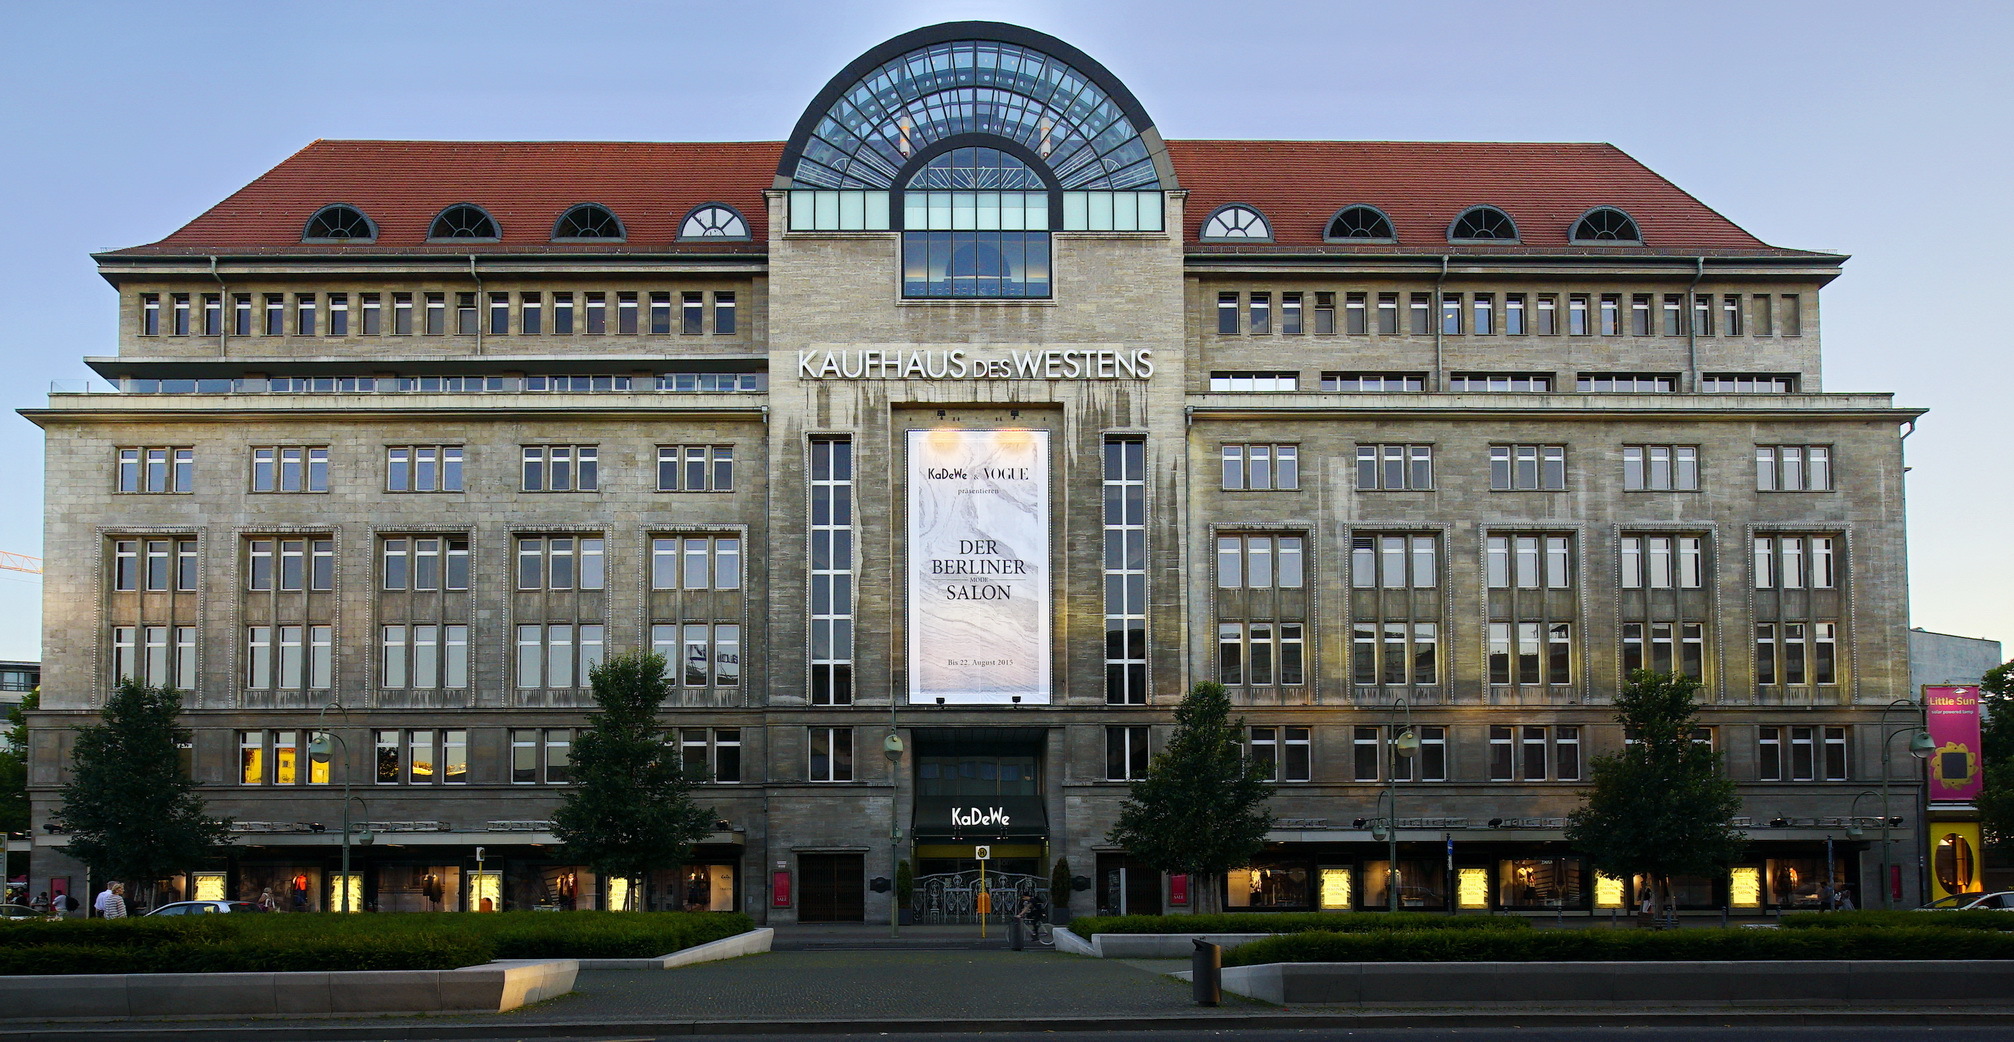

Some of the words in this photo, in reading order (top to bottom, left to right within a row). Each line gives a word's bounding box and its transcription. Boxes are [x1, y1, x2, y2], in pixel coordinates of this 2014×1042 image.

[798, 349, 967, 379] KAUFHAUS
[973, 359, 1012, 378] DES
[1012, 349, 1154, 379] WESTENS
[928, 467, 967, 480] KaDeWe
[983, 467, 1029, 480] VOGUE
[959, 539, 998, 554] DER
[932, 559, 1026, 574] BERLINER
[946, 584, 1011, 600] SALON
[972, 659, 995, 667] August
[1930, 697, 1954, 705] Little
[1956, 697, 1975, 705] Sun
[952, 807, 1010, 825] KaDeWe
